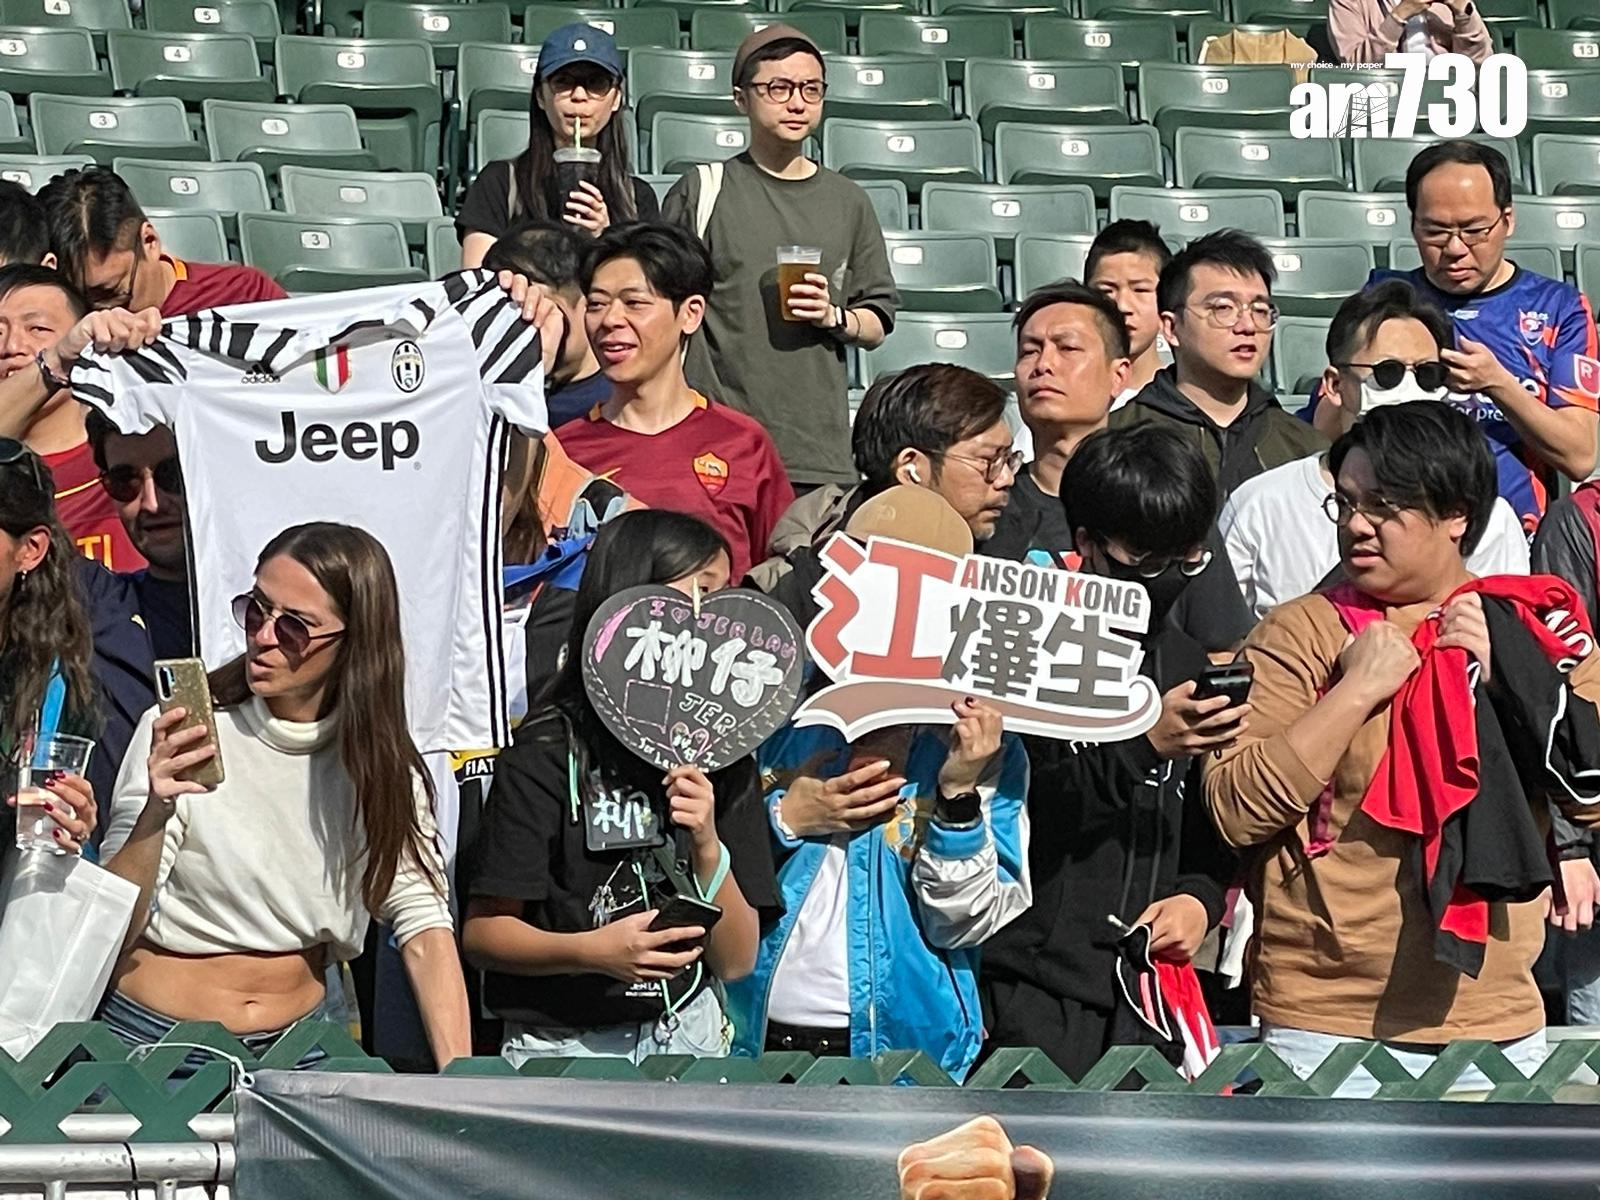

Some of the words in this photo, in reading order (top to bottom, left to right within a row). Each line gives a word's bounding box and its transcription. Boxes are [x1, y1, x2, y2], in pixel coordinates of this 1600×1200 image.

[53, 2, 61, 12] 4
[203, 10, 212, 20] 5
[432, 18, 439, 29] 6
[930, 30, 938, 41] 9
[1092, 34, 1106, 45] 10
[9, 42, 17, 52] 3
[1579, 45, 1594, 56] 13
[174, 49, 182, 59] 4
[348, 55, 355, 66] 5
[698, 67, 706, 76] 7
[866, 72, 873, 82] 8
[1038, 76, 1046, 87] 9
[1208, 80, 1223, 91] 10
[1549, 85, 1562, 96] 12
[99, 115, 107, 126] 3
[726, 133, 734, 144] 6
[897, 139, 905, 149] 7
[1071, 142, 1079, 153] 8
[181, 180, 189, 192] 3
[1002, 203, 1010, 214] 7
[1190, 208, 1199, 219] 8
[1377, 211, 1385, 223] 9
[312, 234, 320, 246] 3
[254, 411, 420, 471] Jeep
[960, 558, 1059, 604] ANSON
[1063, 576, 1142, 619] KONG
[623, 620, 784, 708] 柳仔
[679, 692, 737, 736] JER
[465, 757, 496, 776] FIAT
